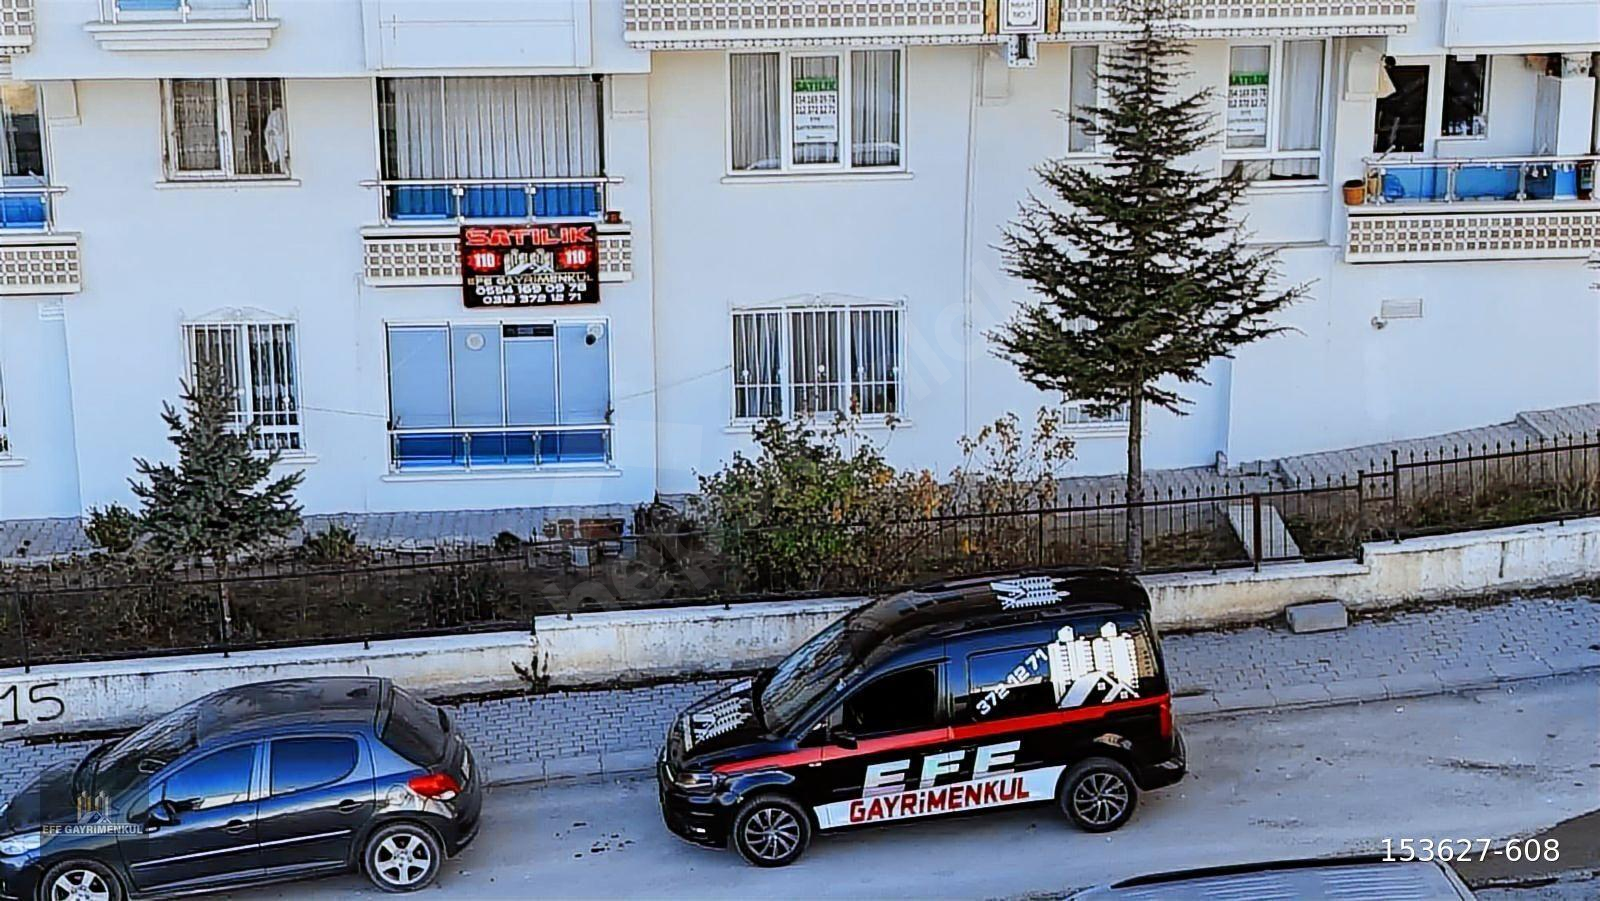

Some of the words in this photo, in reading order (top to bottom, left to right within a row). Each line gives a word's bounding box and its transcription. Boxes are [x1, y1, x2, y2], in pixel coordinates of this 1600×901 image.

[465, 226, 593, 246] SATILIK
[474, 253, 496, 268] 110
[566, 249, 586, 265] 110
[568, 293, 582, 301] 71
[975, 681, 1010, 716] 372
[1006, 664, 1030, 685] 12
[1025, 648, 1048, 672] 71
[0, 682, 65, 726] 15
[862, 740, 1021, 798] EFE
